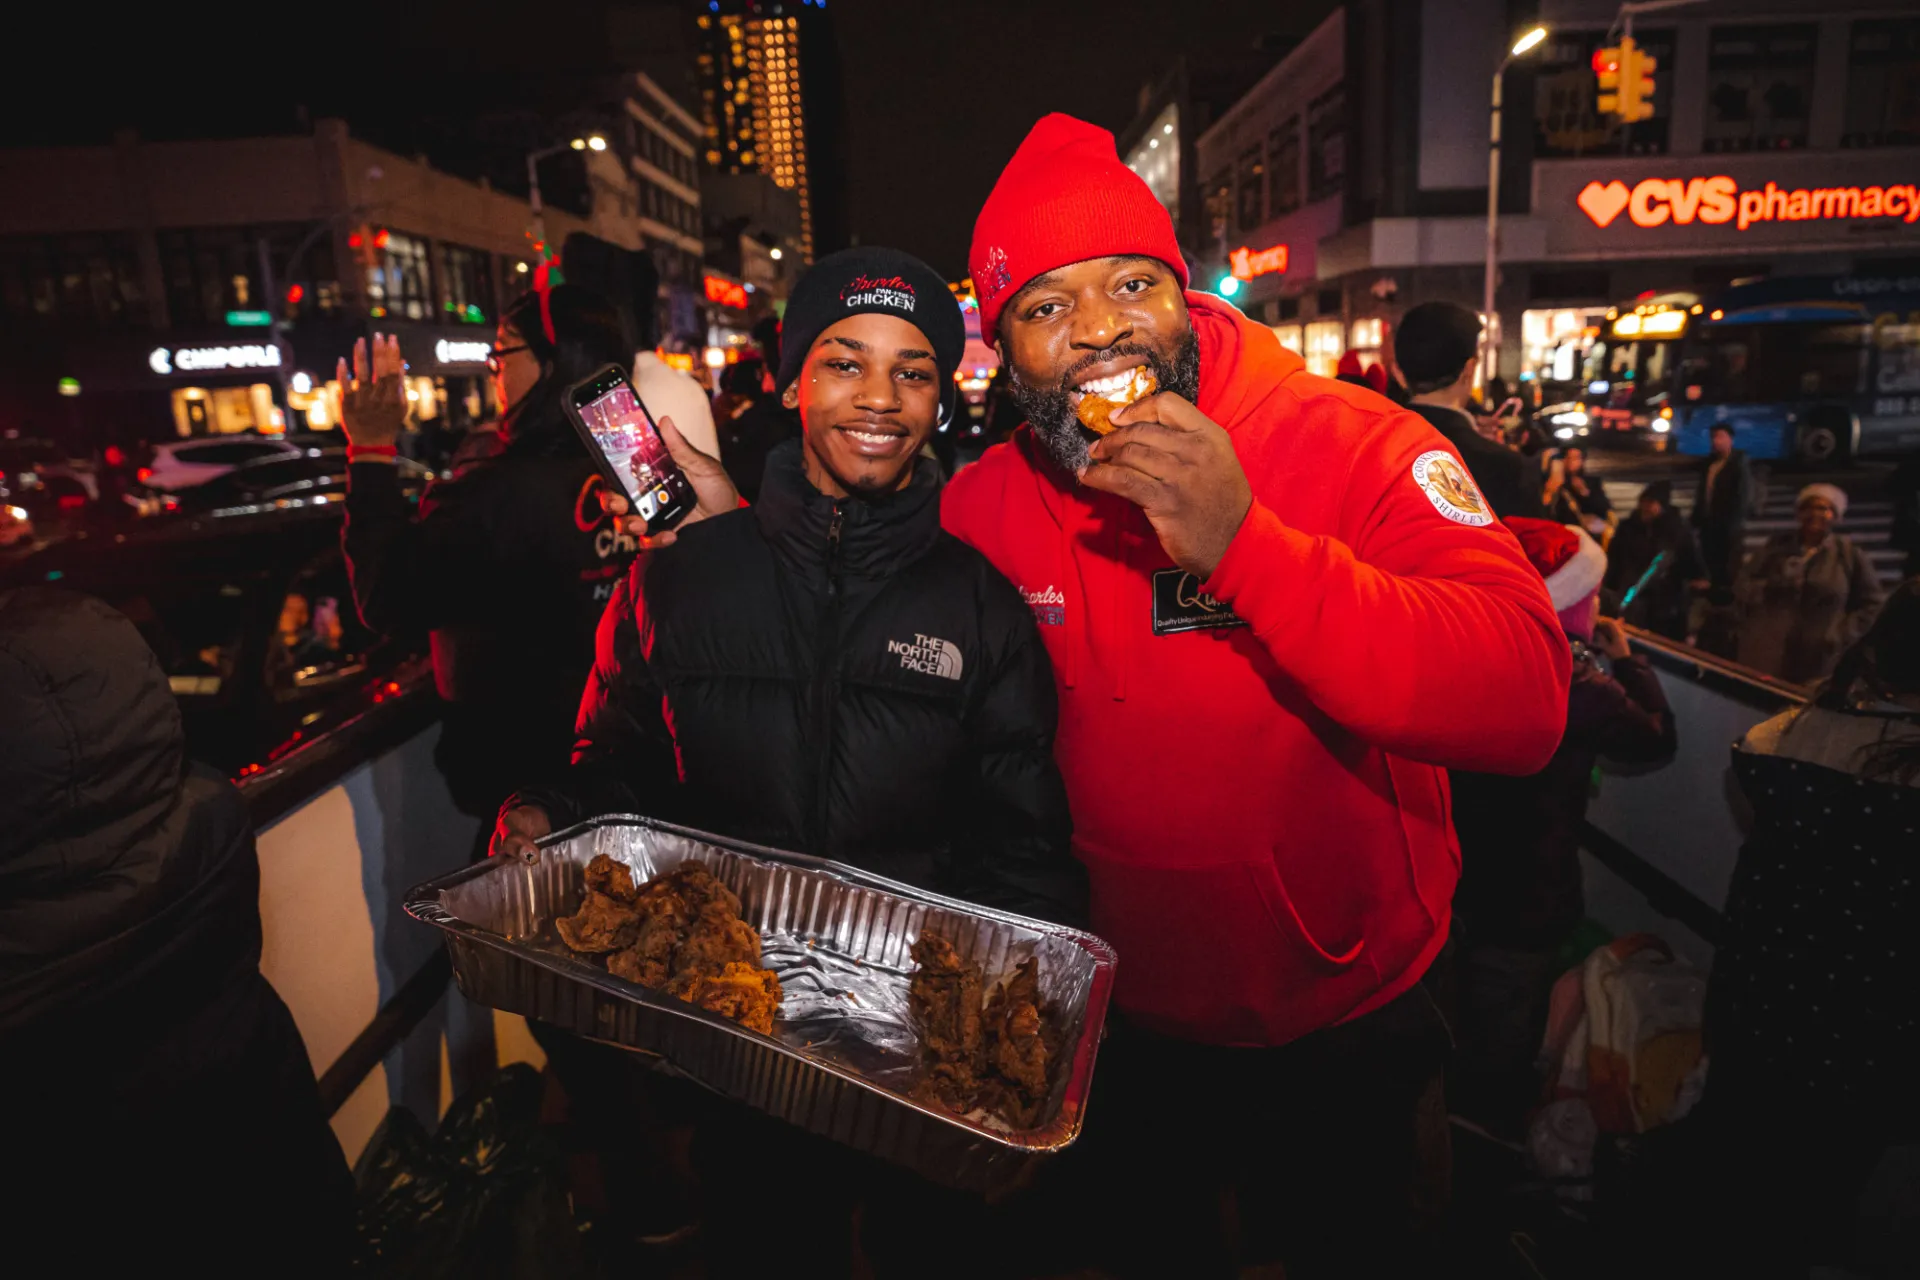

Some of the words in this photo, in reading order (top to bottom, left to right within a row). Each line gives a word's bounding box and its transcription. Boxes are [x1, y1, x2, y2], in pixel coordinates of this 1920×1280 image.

[1628, 176, 1738, 227] CVS
[1737, 181, 1920, 231] pharmacy
[846, 293, 915, 312] CHICKEN
[1433, 496, 1485, 524] SHIRLEY
[888, 640, 941, 663] NORTH
[914, 633, 943, 651] THE
[900, 656, 937, 674] FACE
